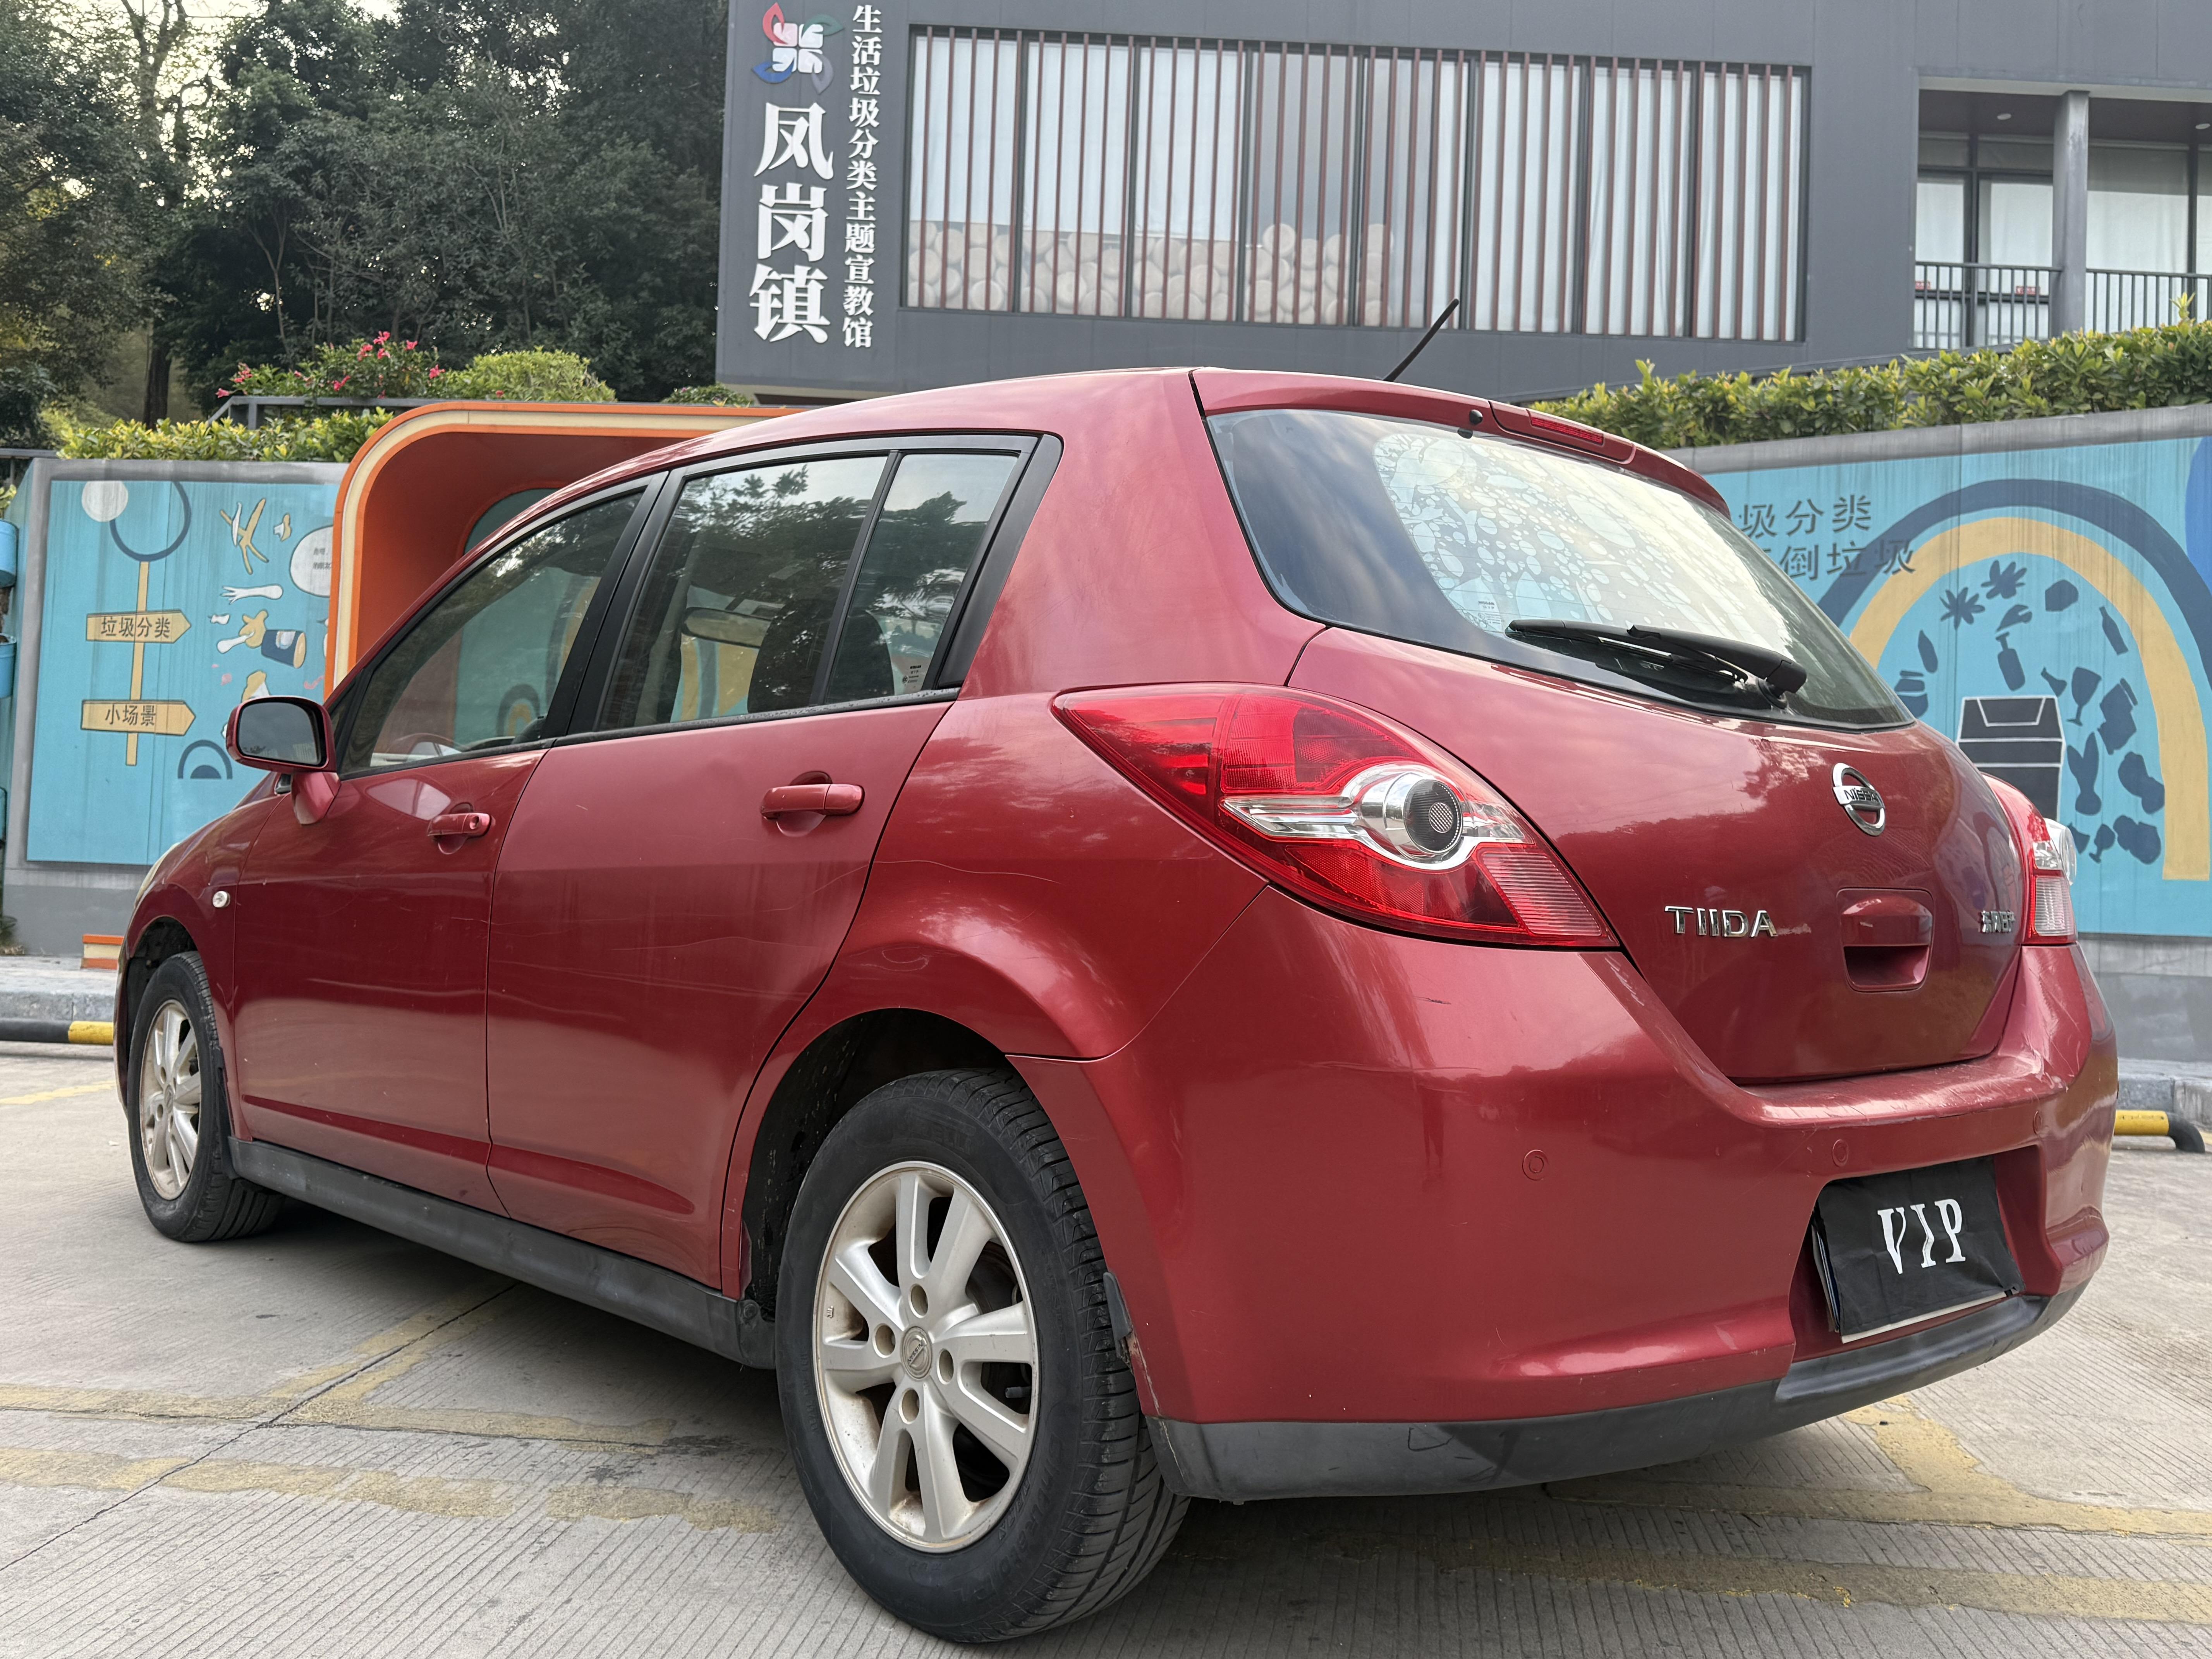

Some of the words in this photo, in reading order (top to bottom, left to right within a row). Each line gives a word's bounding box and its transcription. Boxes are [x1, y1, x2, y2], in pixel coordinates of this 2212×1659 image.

[842, 5, 883, 348] 生活垃圾分类主题宣教馆
[749, 102, 834, 343] 凤岗镇
[1739, 495, 1871, 539] 圾分类
[1763, 541, 1915, 580] 倒垃圾
[101, 616, 170, 638] 垃圾分类
[105, 704, 156, 726] 小场景
[1664, 905, 1778, 938] TIIDA
[1877, 1199, 1966, 1274] VIP
